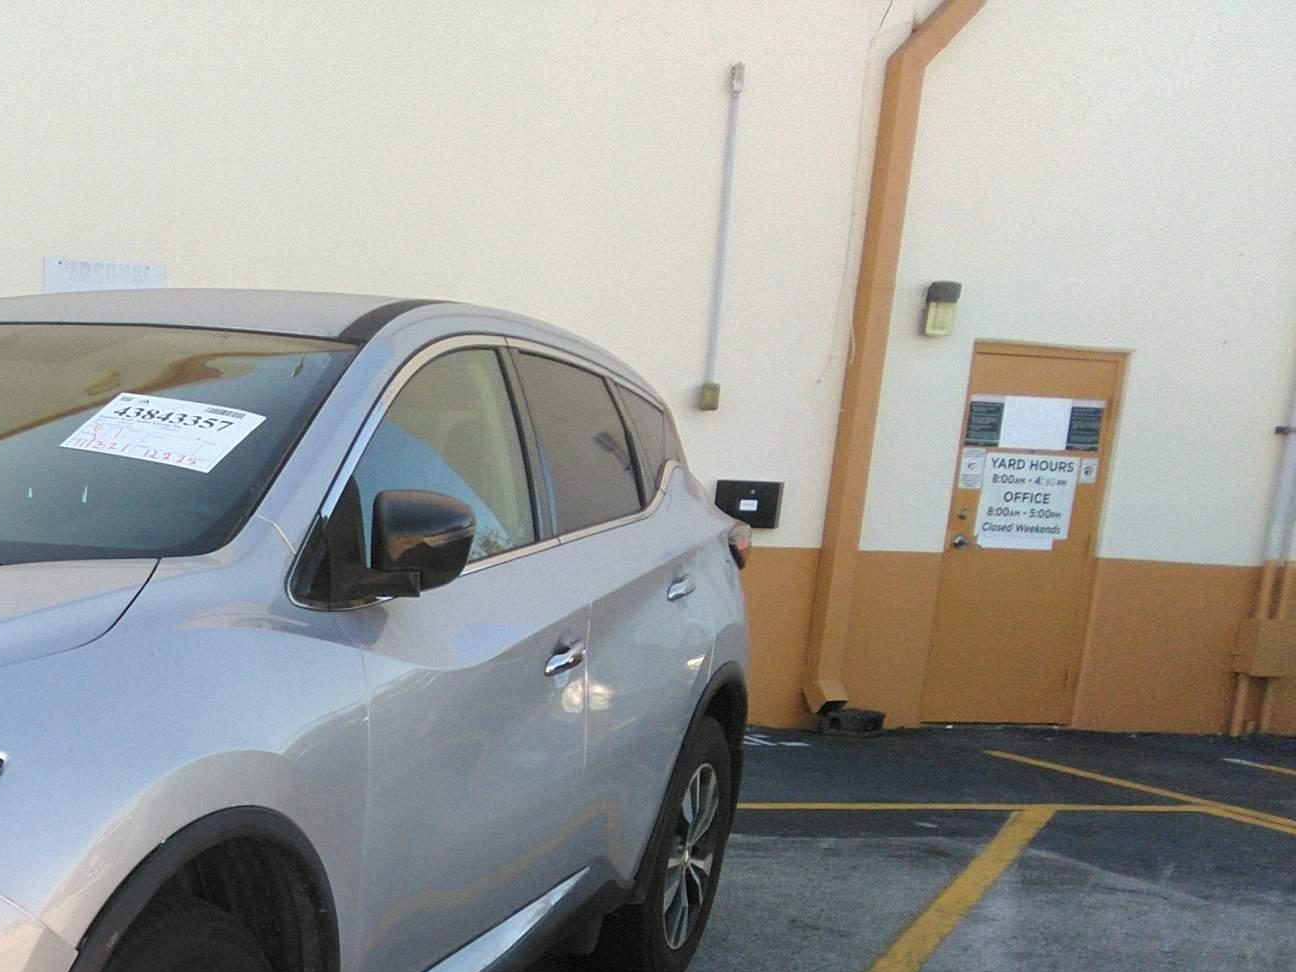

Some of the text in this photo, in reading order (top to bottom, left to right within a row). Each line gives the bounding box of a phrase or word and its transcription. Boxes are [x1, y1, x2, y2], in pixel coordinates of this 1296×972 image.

[113, 406, 234, 432] 43843357
[991, 458, 1025, 470] YARD
[1030, 461, 1074, 473] HOURS
[1004, 491, 1051, 504] OFFICE
[982, 522, 1061, 534] Closed Weekends
